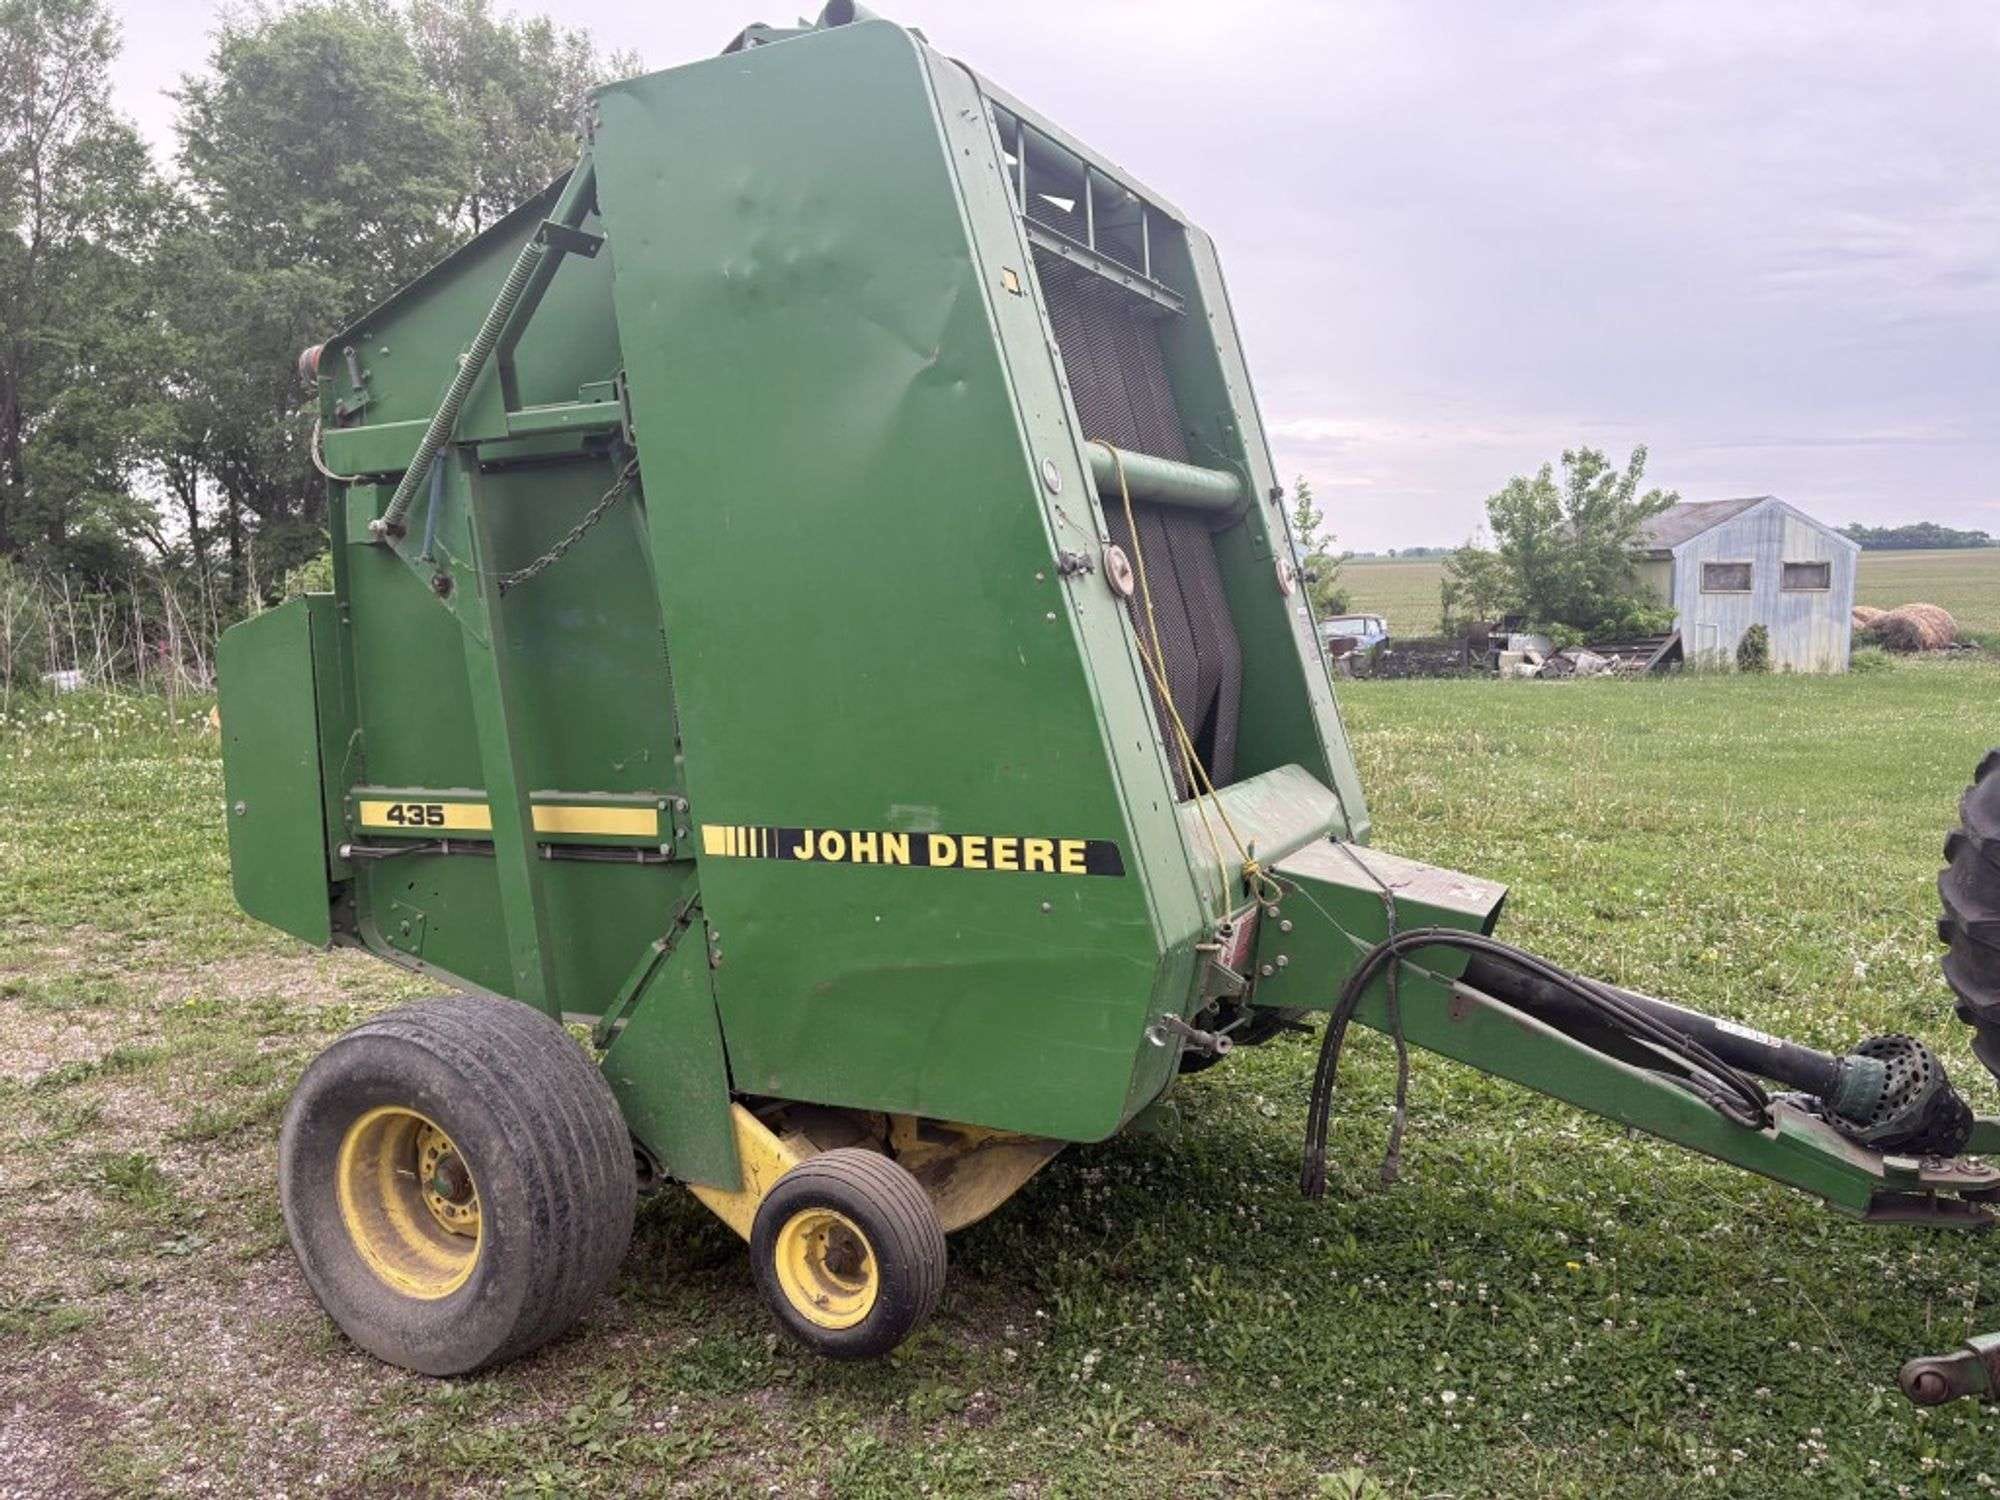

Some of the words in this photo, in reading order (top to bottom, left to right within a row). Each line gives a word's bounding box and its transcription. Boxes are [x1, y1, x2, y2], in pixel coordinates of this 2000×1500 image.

[387, 804, 444, 825] 435
[793, 830, 910, 865] JOHN
[928, 834, 1087, 874] DEERE
